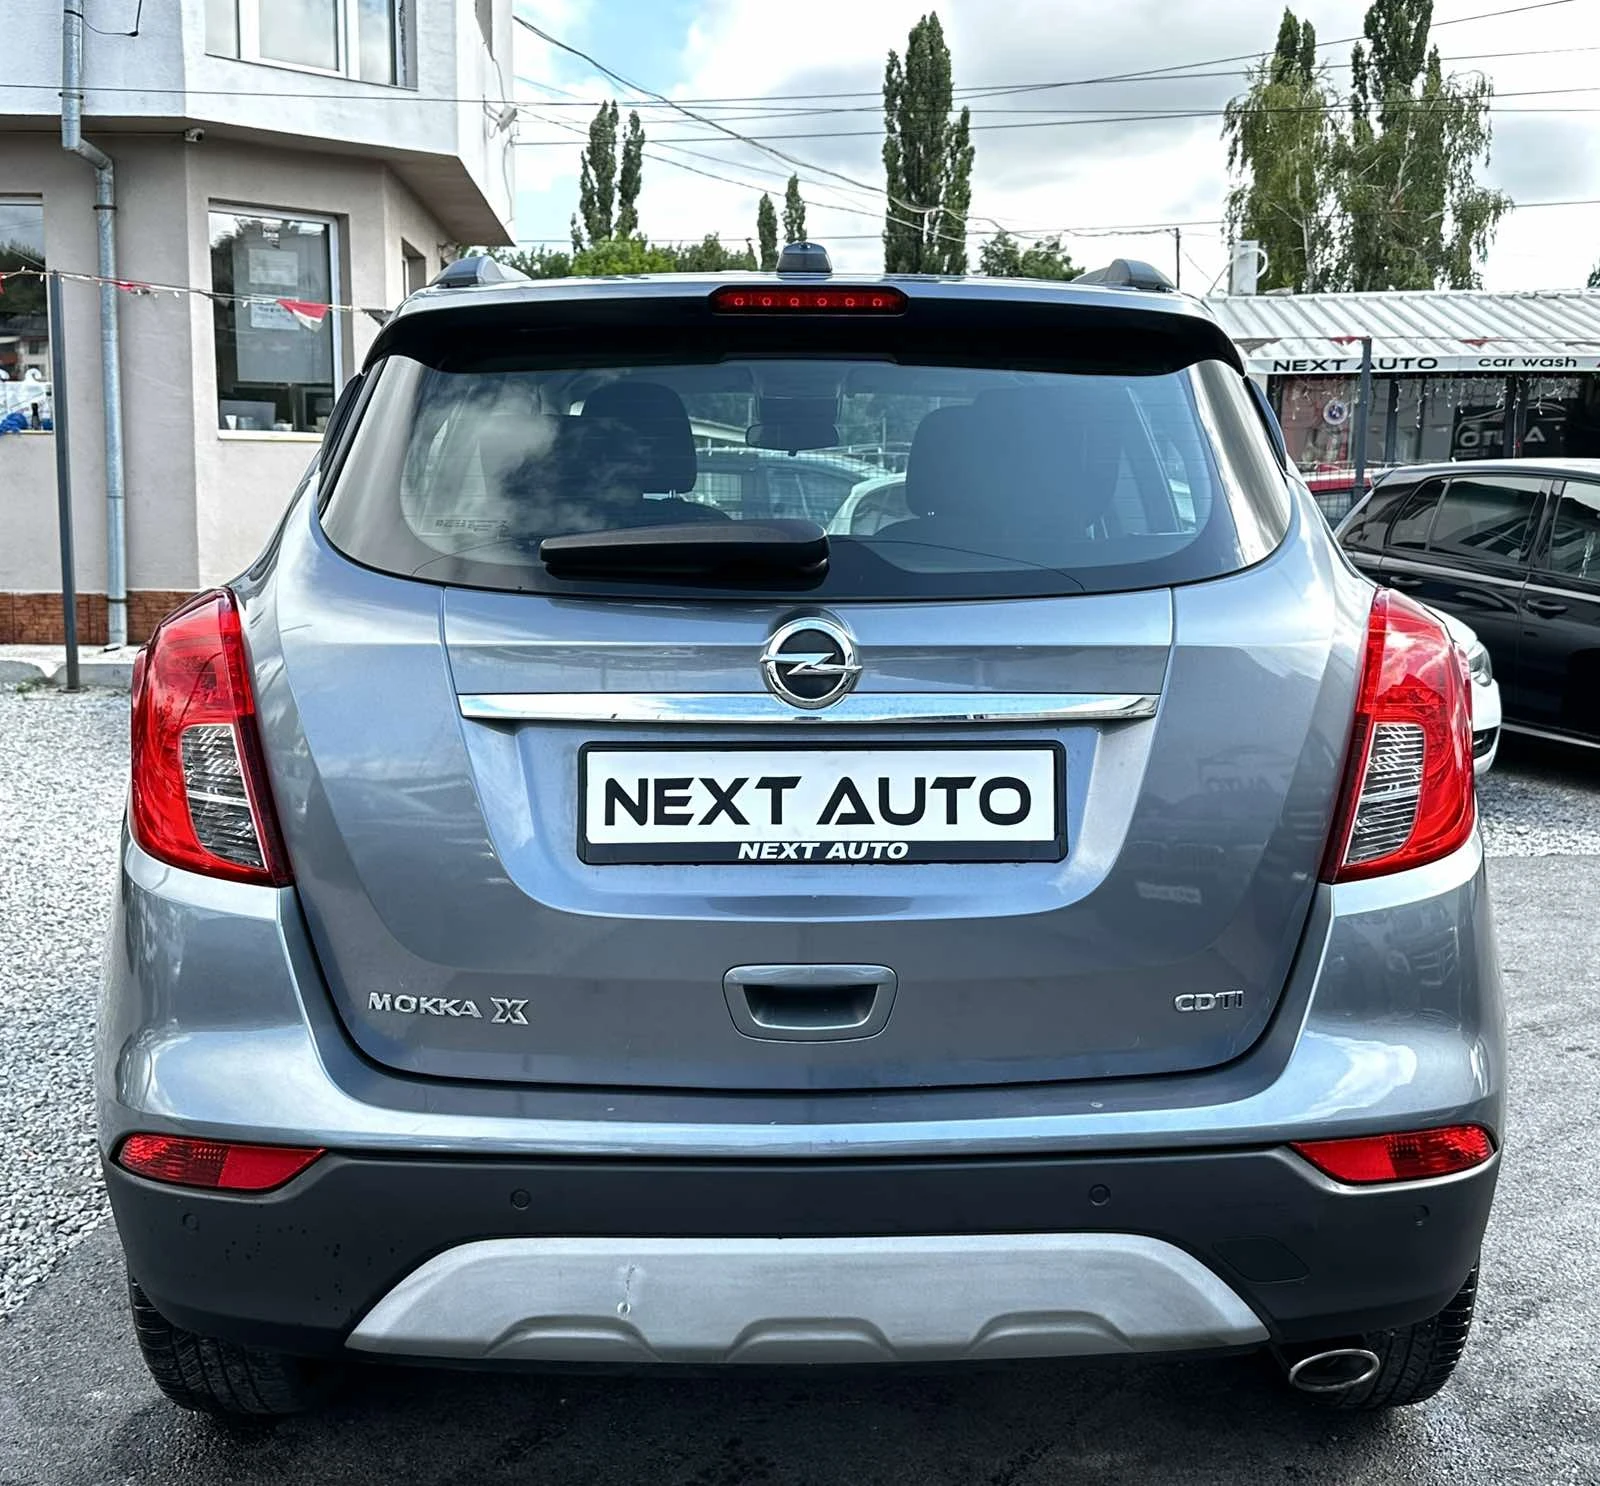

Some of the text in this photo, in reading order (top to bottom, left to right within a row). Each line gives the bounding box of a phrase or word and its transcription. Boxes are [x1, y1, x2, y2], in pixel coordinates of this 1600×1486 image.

[1273, 359, 1348, 372] NEXT
[1478, 358, 1515, 367] car
[1521, 356, 1577, 367] wash
[604, 776, 1032, 826] NEXT AUTO
[737, 842, 909, 860] NEXT AUTO
[368, 991, 530, 1025] MOKKA X
[1174, 990, 1244, 1012] CDTI
